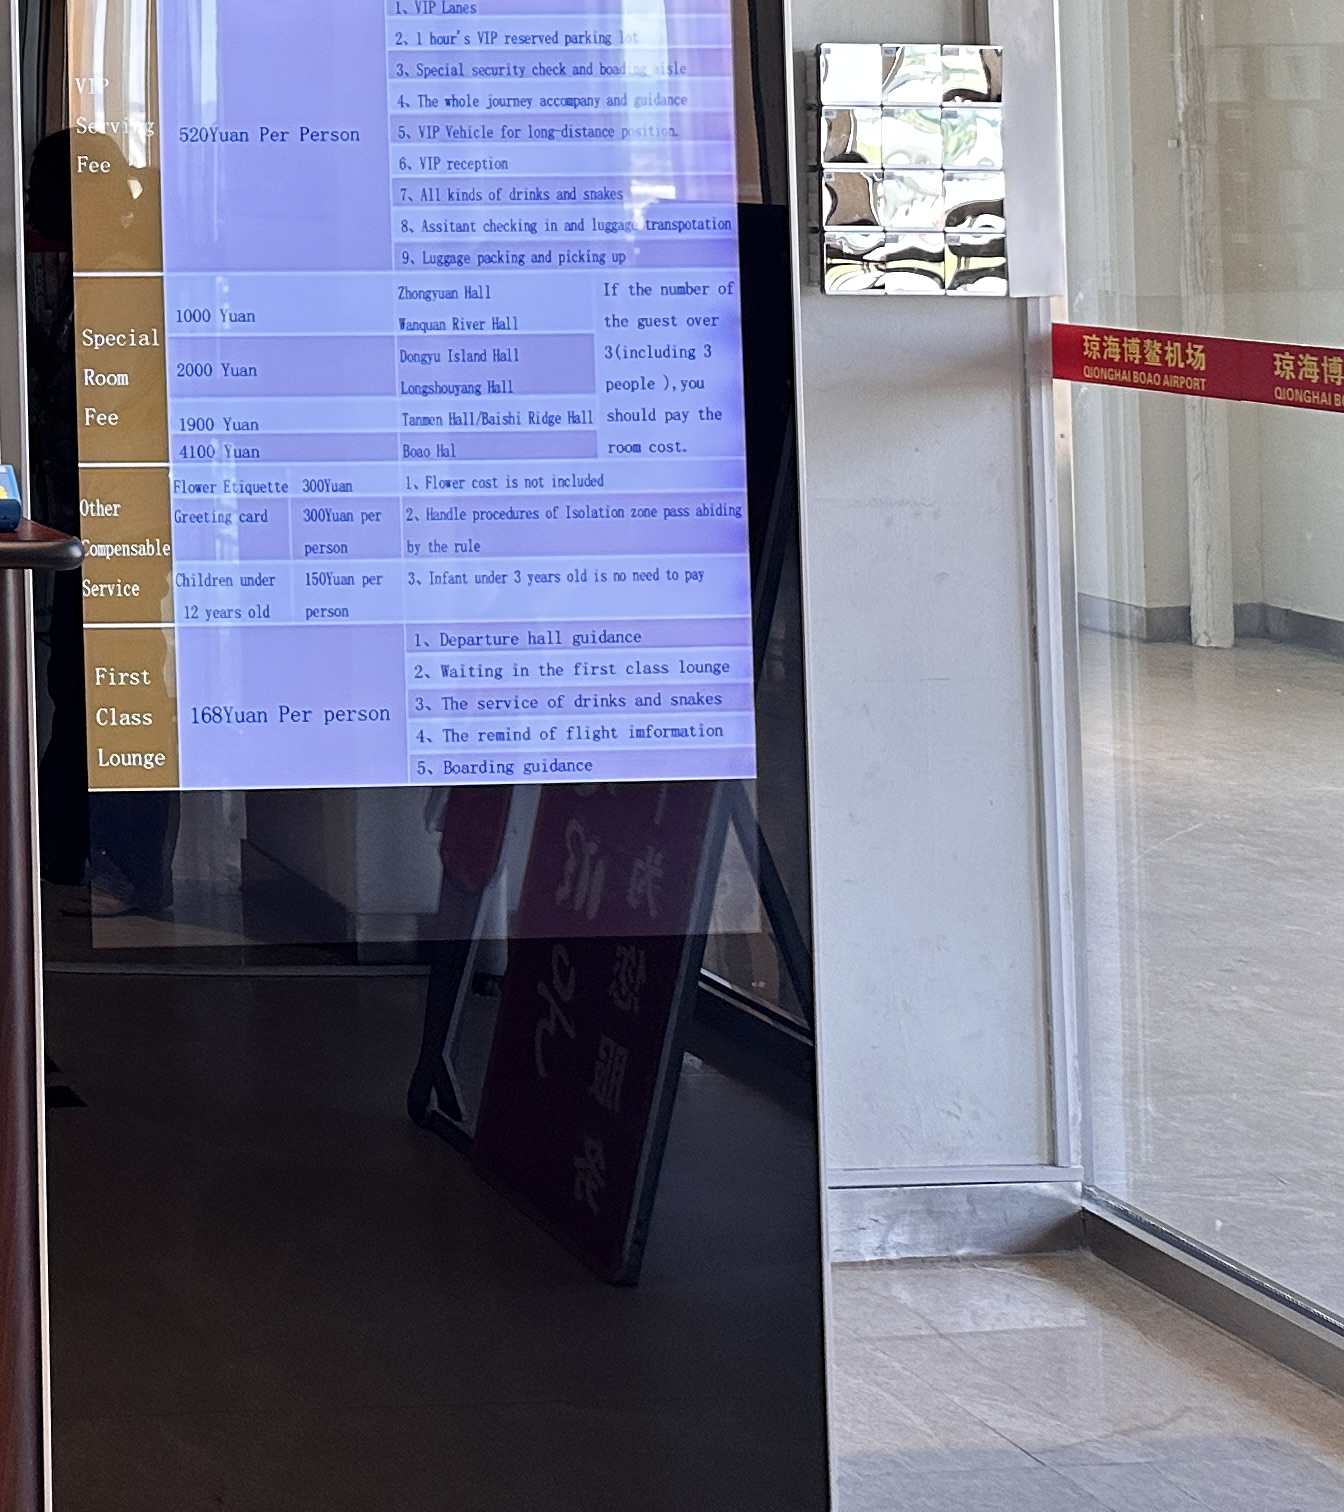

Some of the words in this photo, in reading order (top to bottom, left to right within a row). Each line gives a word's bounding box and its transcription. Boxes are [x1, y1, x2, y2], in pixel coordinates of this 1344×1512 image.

[442, 0, 477, 15] Lanes
[179, 127, 249, 142] 520Yuan
[260, 127, 290, 142] Per
[299, 127, 360, 142] Person
[77, 156, 111, 173] Fee
[446, 157, 508, 172] reception
[447, 187, 482, 202] kinds
[488, 187, 503, 201] of
[509, 187, 549, 201] drinks
[556, 187, 577, 201] and
[583, 189, 623, 201] snakes
[398, 286, 458, 302] Zhongyuan
[464, 285, 491, 300] Hall
[604, 283, 619, 297] If
[629, 283, 652, 296] the
[660, 283, 710, 296] number
[718, 282, 735, 296] of
[176, 310, 211, 323] 1000
[220, 309, 256, 323] Yuan
[604, 314, 628, 328] the
[636, 314, 677, 330] guest
[686, 315, 719, 327] over
[399, 318, 446, 333] Wanquan
[452, 318, 486, 331] River
[491, 317, 518, 331] Hall
[82, 329, 159, 349] Special
[400, 349, 441, 365] Dongyu
[447, 349, 487, 363] Island
[492, 348, 519, 362] Hall
[1083, 334, 1207, 370] 琼海博鳌机场
[83, 369, 129, 386] Room
[176, 364, 213, 378] 2000
[221, 364, 258, 378] Yuan
[1083, 366, 1131, 383] QIONGHAI
[1133, 370, 1161, 386] BOAO
[1163, 373, 1207, 390] AIRPORT
[400, 381, 482, 396] Longshouyang
[487, 380, 514, 394] Hall
[1274, 387, 1332, 406] QIONGHAI
[84, 409, 119, 426] Fee
[179, 418, 215, 432] 1900
[223, 418, 260, 432] Yuan
[179, 445, 215, 460] 4100
[224, 445, 260, 459] Yuan
[173, 481, 216, 494] Flower
[223, 480, 289, 495] Etiquette
[302, 479, 353, 493] 300Yuan
[80, 500, 121, 517] Other
[303, 509, 354, 523] 300Yuan
[361, 510, 382, 524] per
[174, 510, 232, 525] Greeting
[239, 510, 268, 523] card
[81, 539, 171, 557] Compensable
[305, 542, 348, 557] person
[83, 580, 140, 598] Service
[527, 631, 562, 645] hall
[572, 630, 642, 646] guidance
[95, 667, 151, 686] First
[512, 664, 529, 677] in
[538, 663, 564, 676] the
[574, 662, 616, 676] first
[626, 660, 669, 675] class
[679, 660, 730, 675] lounge
[96, 707, 153, 726] Class
[191, 706, 268, 724] 168Yuan
[279, 705, 312, 723] Per
[324, 706, 391, 725] person
[98, 748, 166, 769] Lounge
[523, 759, 593, 775] guidance
